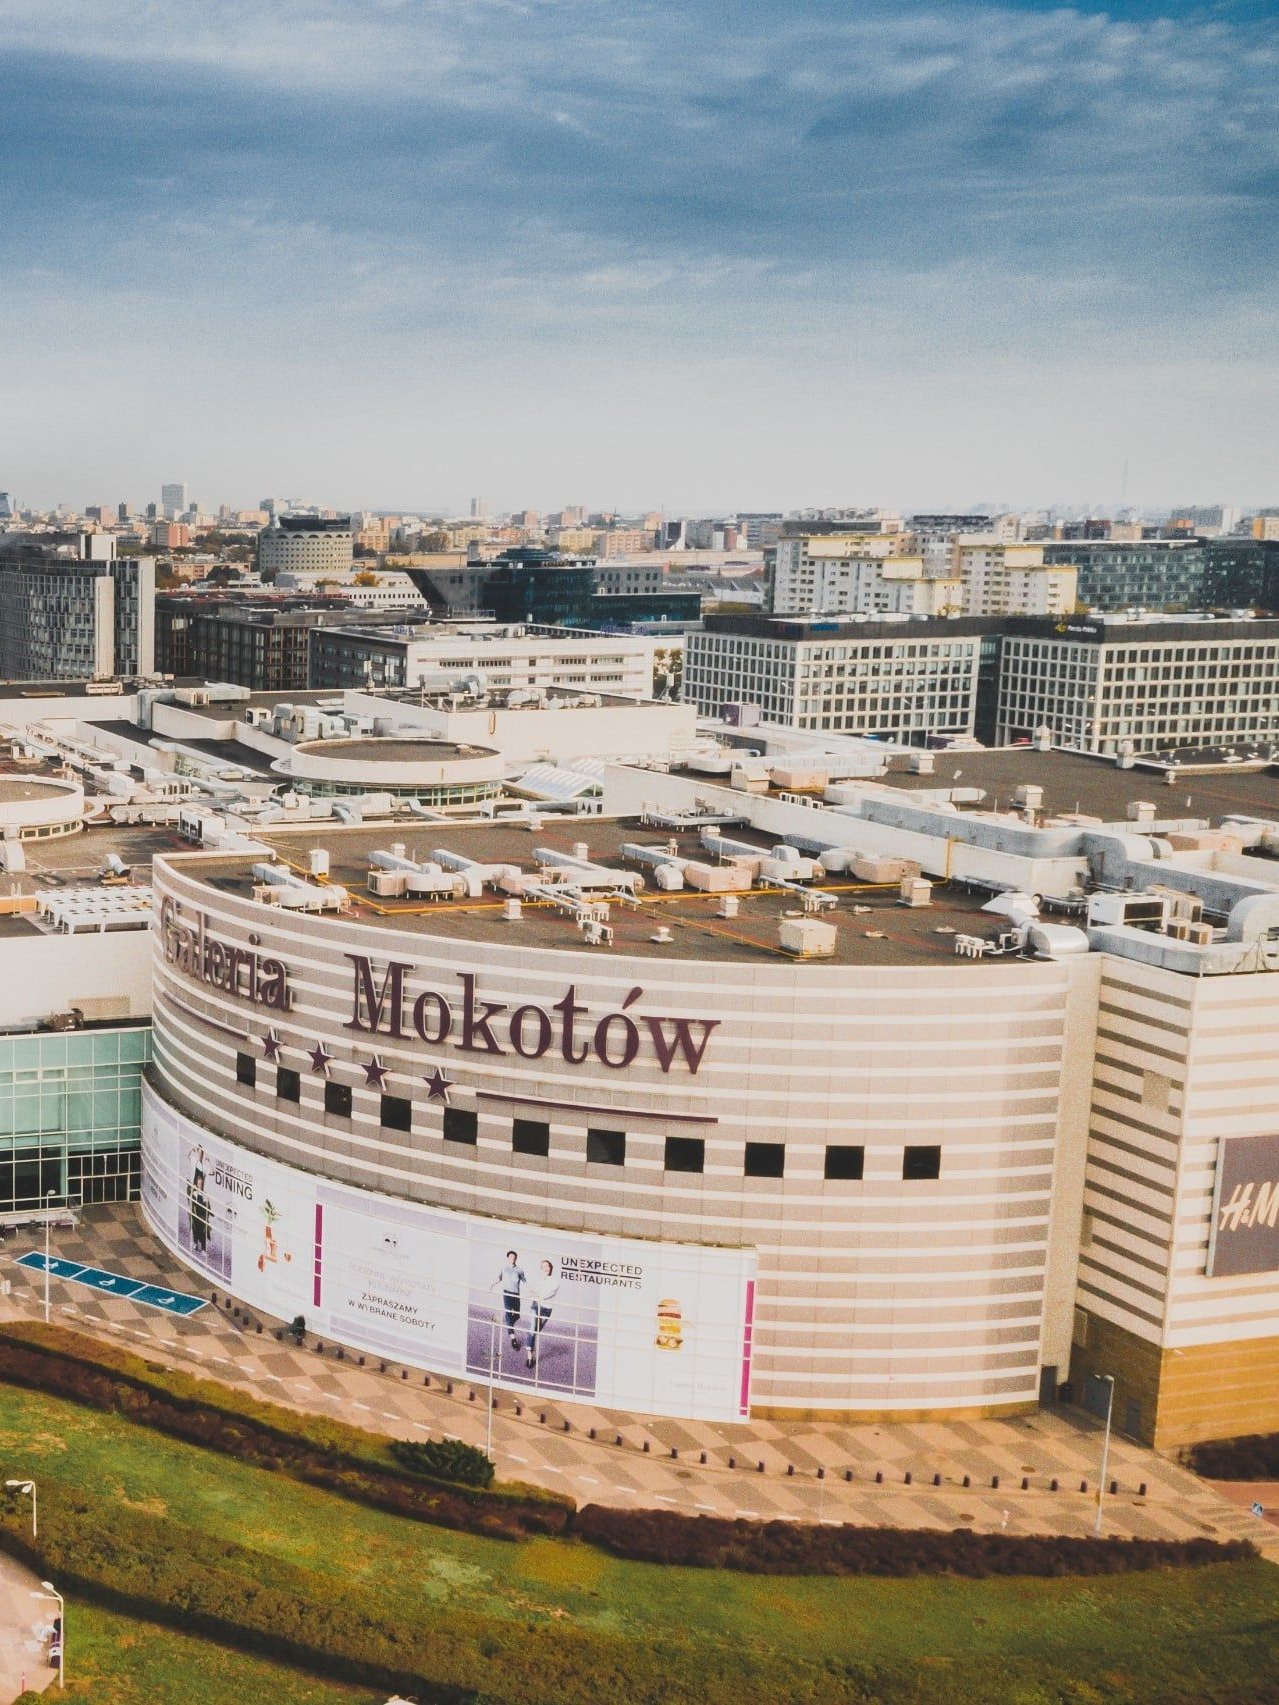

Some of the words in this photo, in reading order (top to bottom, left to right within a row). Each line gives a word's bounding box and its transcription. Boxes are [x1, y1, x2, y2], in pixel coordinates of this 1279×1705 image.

[160, 895, 292, 1012] Galeria
[342, 952, 722, 1075] Mokotów
[215, 1159, 253, 1183] UNEXPECTED
[215, 1170, 253, 1201] DINING
[561, 1256, 643, 1276] UNEXPECTED
[561, 1271, 642, 1290] RESTAURANTS
[347, 1299, 356, 1307] W
[361, 1292, 418, 1315] ZAPRASZAMY
